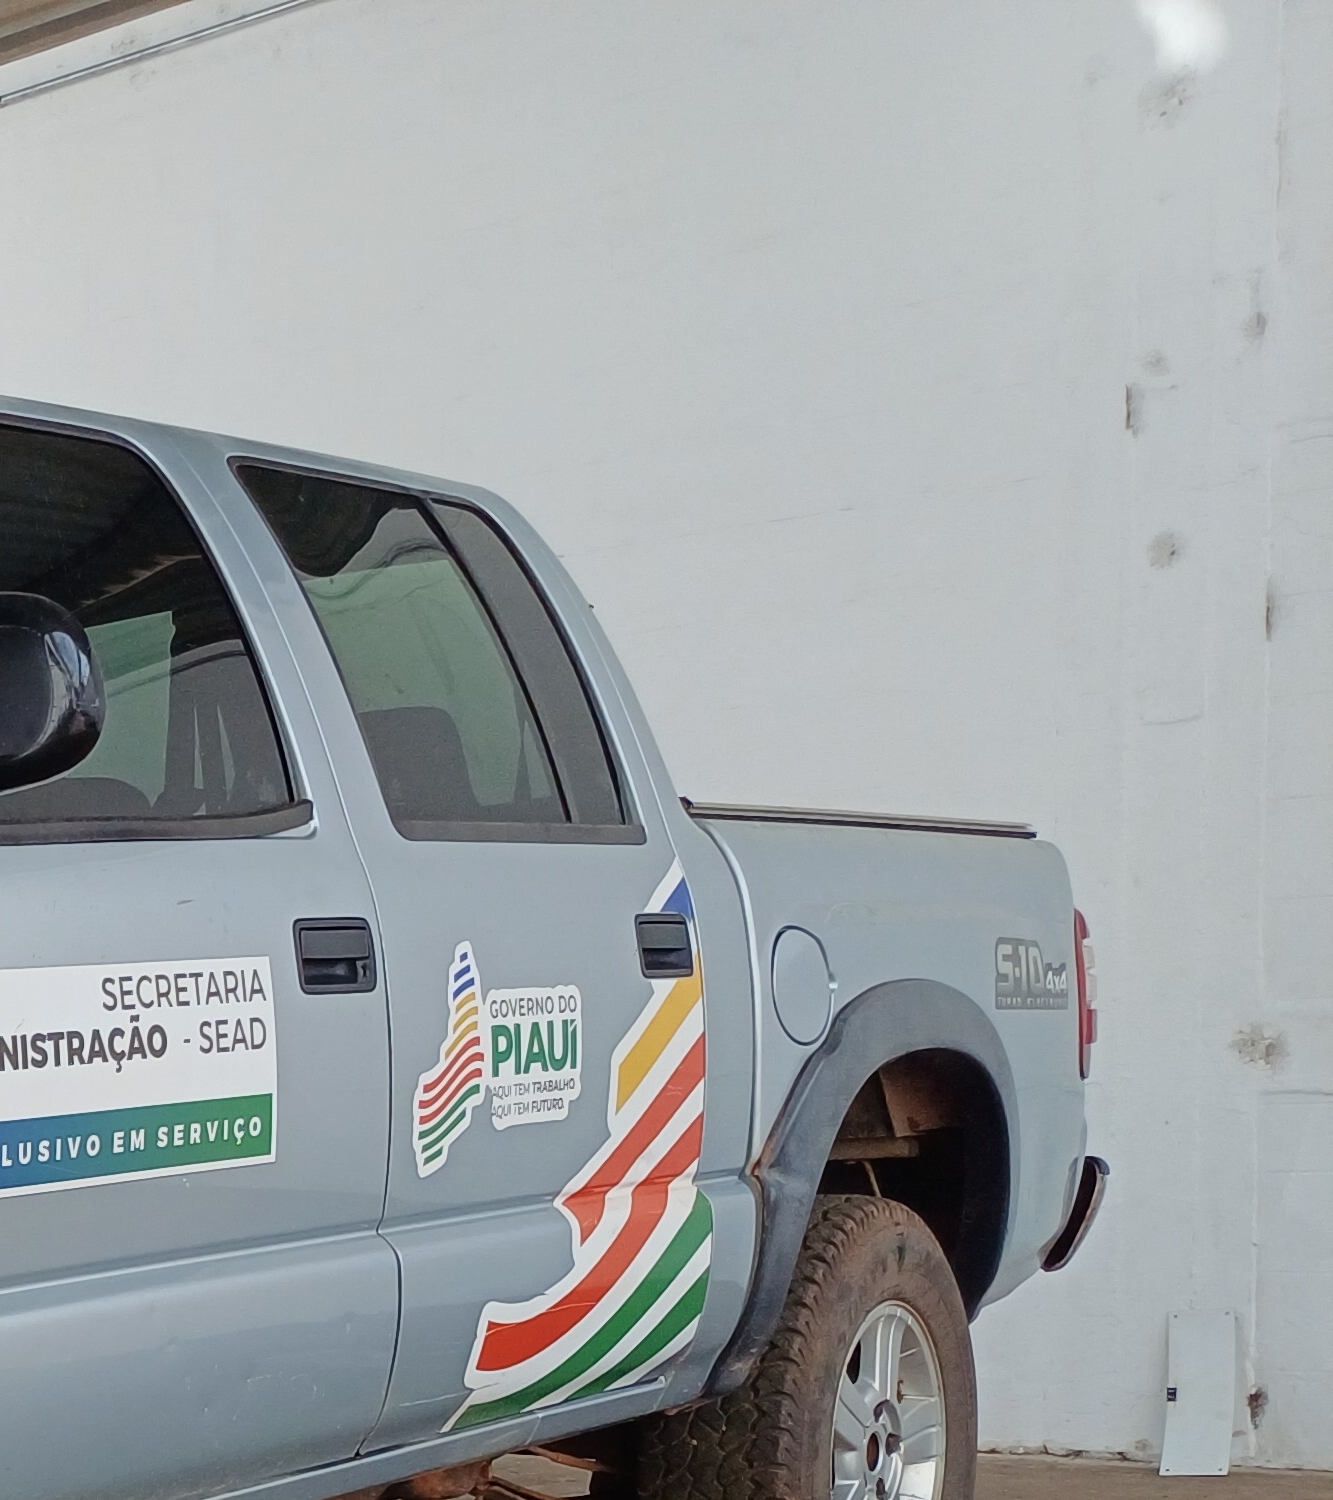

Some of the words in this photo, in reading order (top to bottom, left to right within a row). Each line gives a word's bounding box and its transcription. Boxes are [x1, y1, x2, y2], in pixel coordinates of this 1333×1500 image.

[100, 967, 267, 1012] SECRETARIA
[489, 995, 554, 1019] GOVERNO
[558, 994, 577, 1014] DO
[198, 1016, 268, 1054] SEAD
[490, 1018, 578, 1079] PIAUÍ
[492, 1085, 512, 1100] AQUI
[513, 1082, 531, 1097] TEM
[532, 1077, 576, 1095] TRABALHO
[491, 1103, 512, 1120] AQUI
[513, 1101, 530, 1116] TEM
[112, 1128, 146, 1154] EM
[156, 1115, 263, 1149] SERVIÇO
